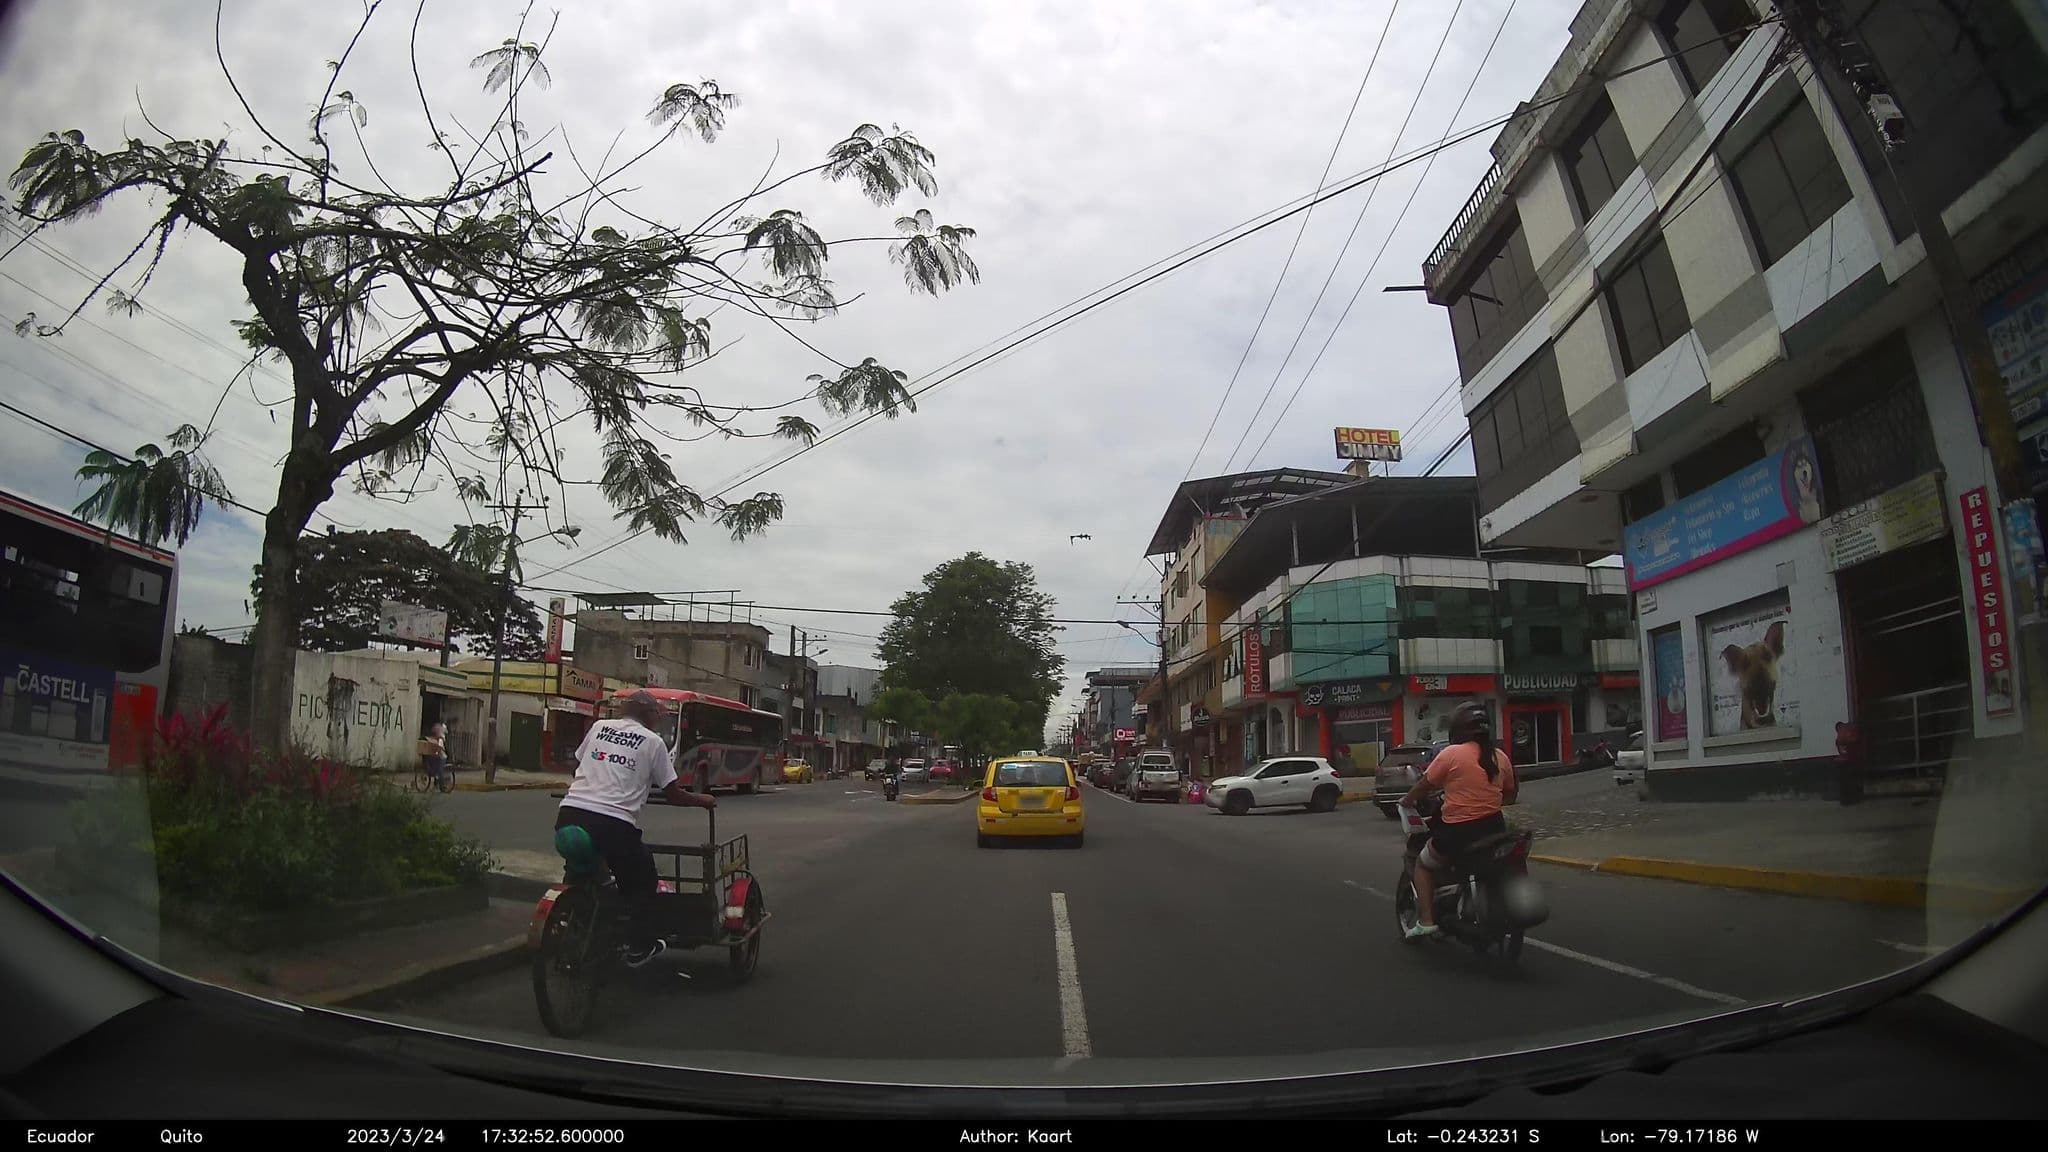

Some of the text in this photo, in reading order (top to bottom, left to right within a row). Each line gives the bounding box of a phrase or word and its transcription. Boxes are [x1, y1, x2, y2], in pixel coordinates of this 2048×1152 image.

[1337, 427, 1400, 444] HOTEL
[1339, 443, 1400, 459] JIMMY
[1968, 493, 2004, 669] REPUESTOS
[17, 668, 90, 703] CASTELL
[1503, 672, 1577, 689] PUBLICIDAD
[596, 732, 643, 750] WILSON!
